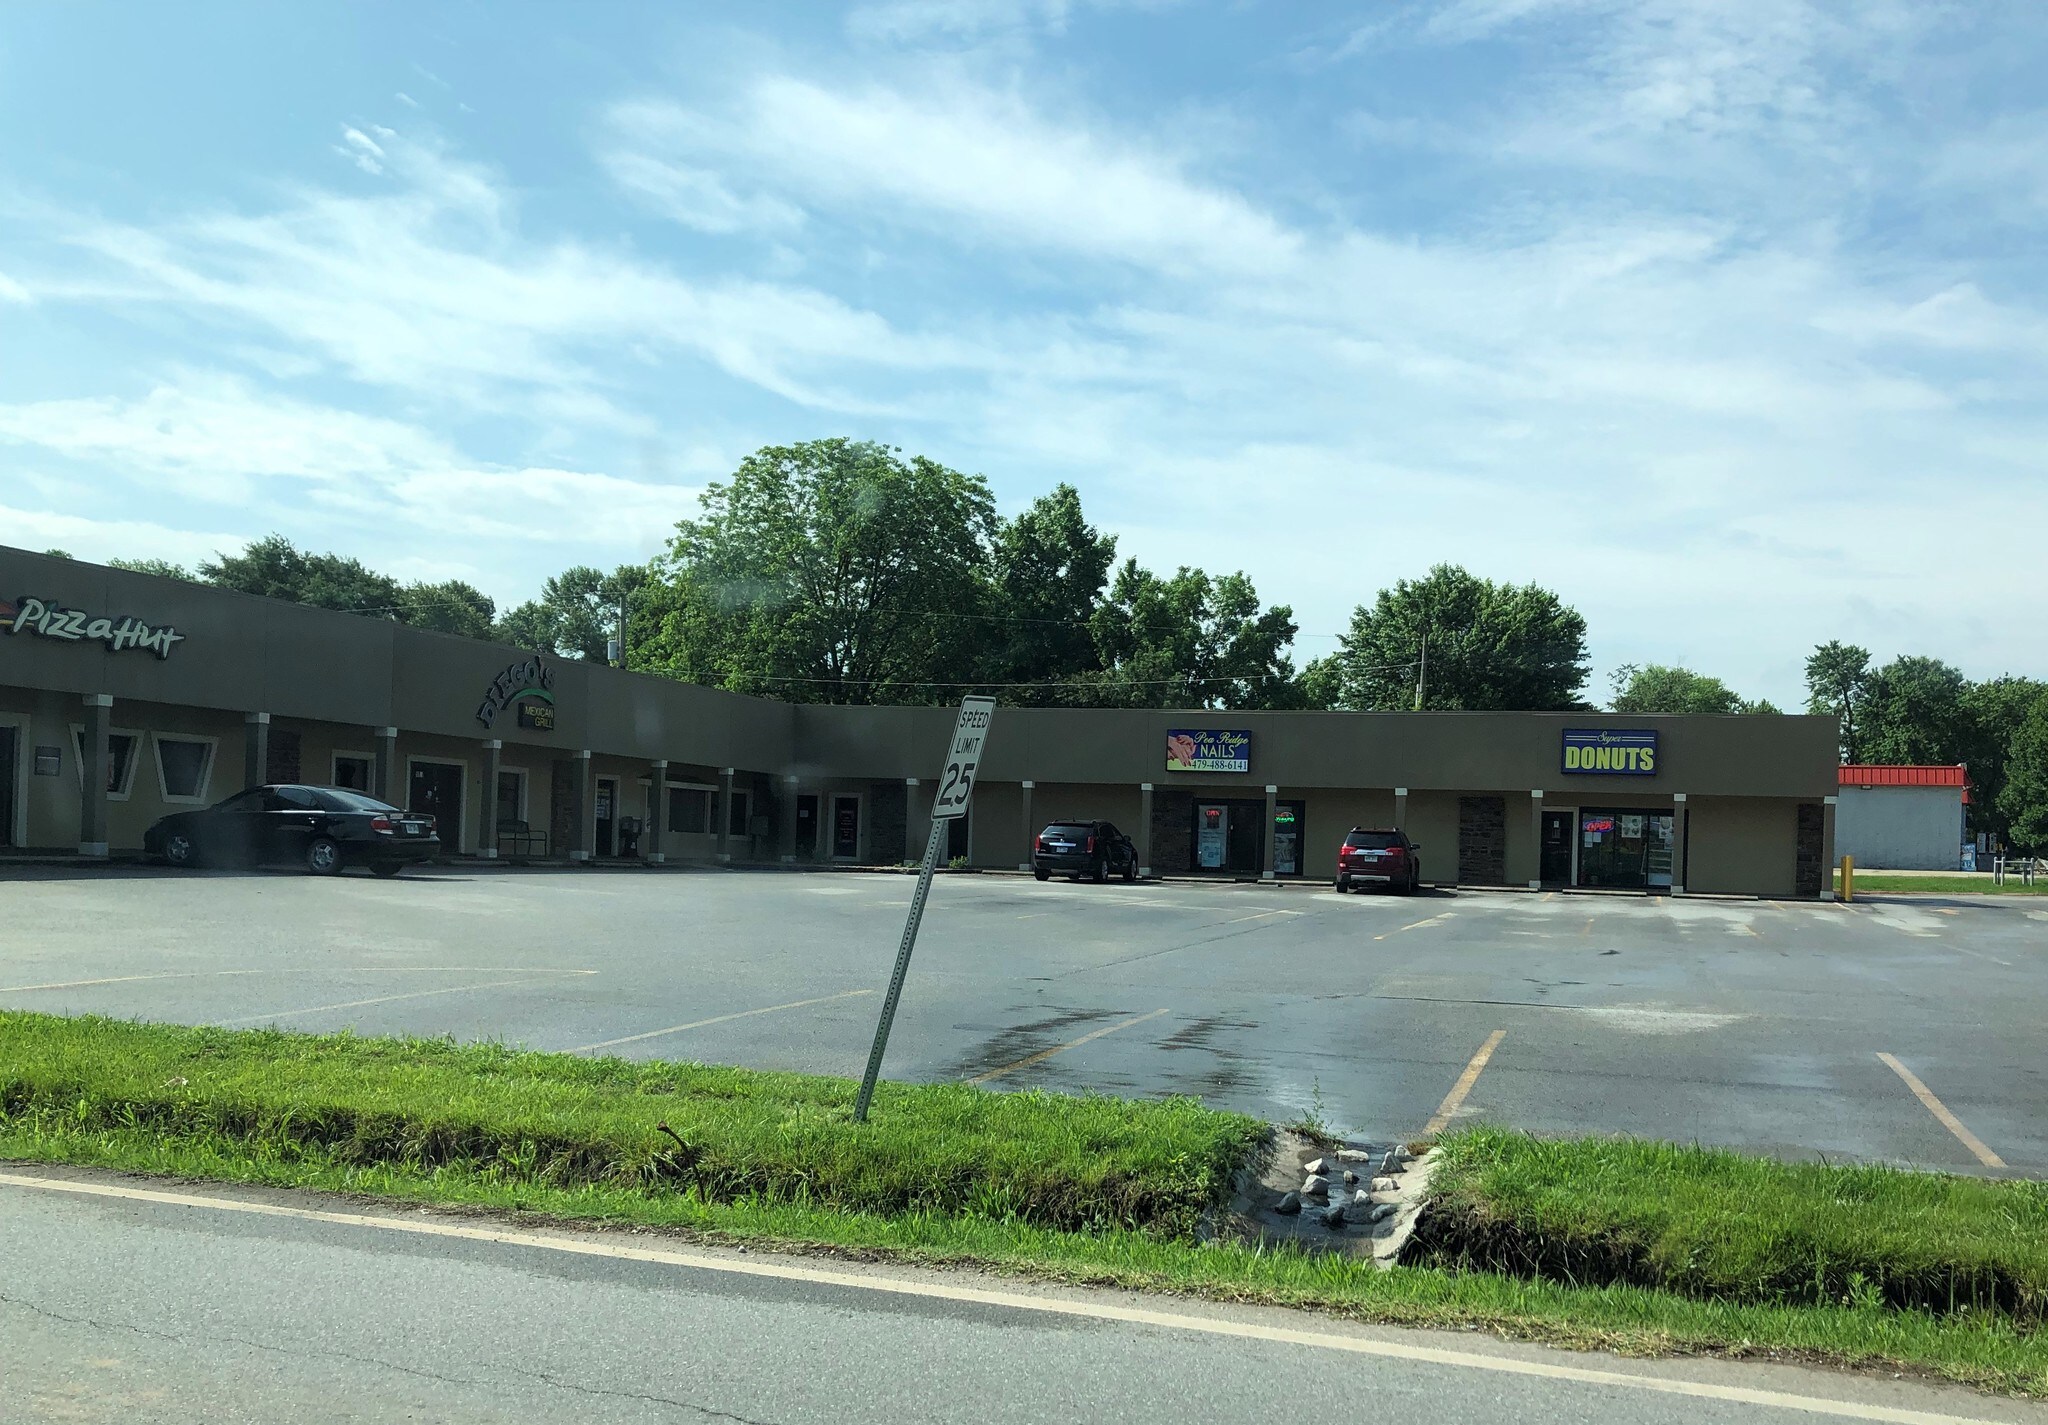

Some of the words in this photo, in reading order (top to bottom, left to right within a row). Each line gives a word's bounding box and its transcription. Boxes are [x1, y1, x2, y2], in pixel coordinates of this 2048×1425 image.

[13, 598, 113, 639] Pizza
[112, 617, 185, 658] Hut
[524, 705, 554, 719] MEXICAN
[959, 710, 990, 728] SPEED
[534, 716, 553, 729] GRILL
[955, 737, 981, 754] LIMIT
[1194, 731, 1215, 744] Pea
[1216, 731, 1249, 748] Ridge
[1596, 730, 1622, 745] Super
[1200, 744, 1235, 758] NAILS
[1565, 746, 1654, 771] DONUTS
[1191, 760, 1247, 770] 479-488-6141
[938, 762, 975, 806] 25
[1586, 820, 1612, 832] OPEN
